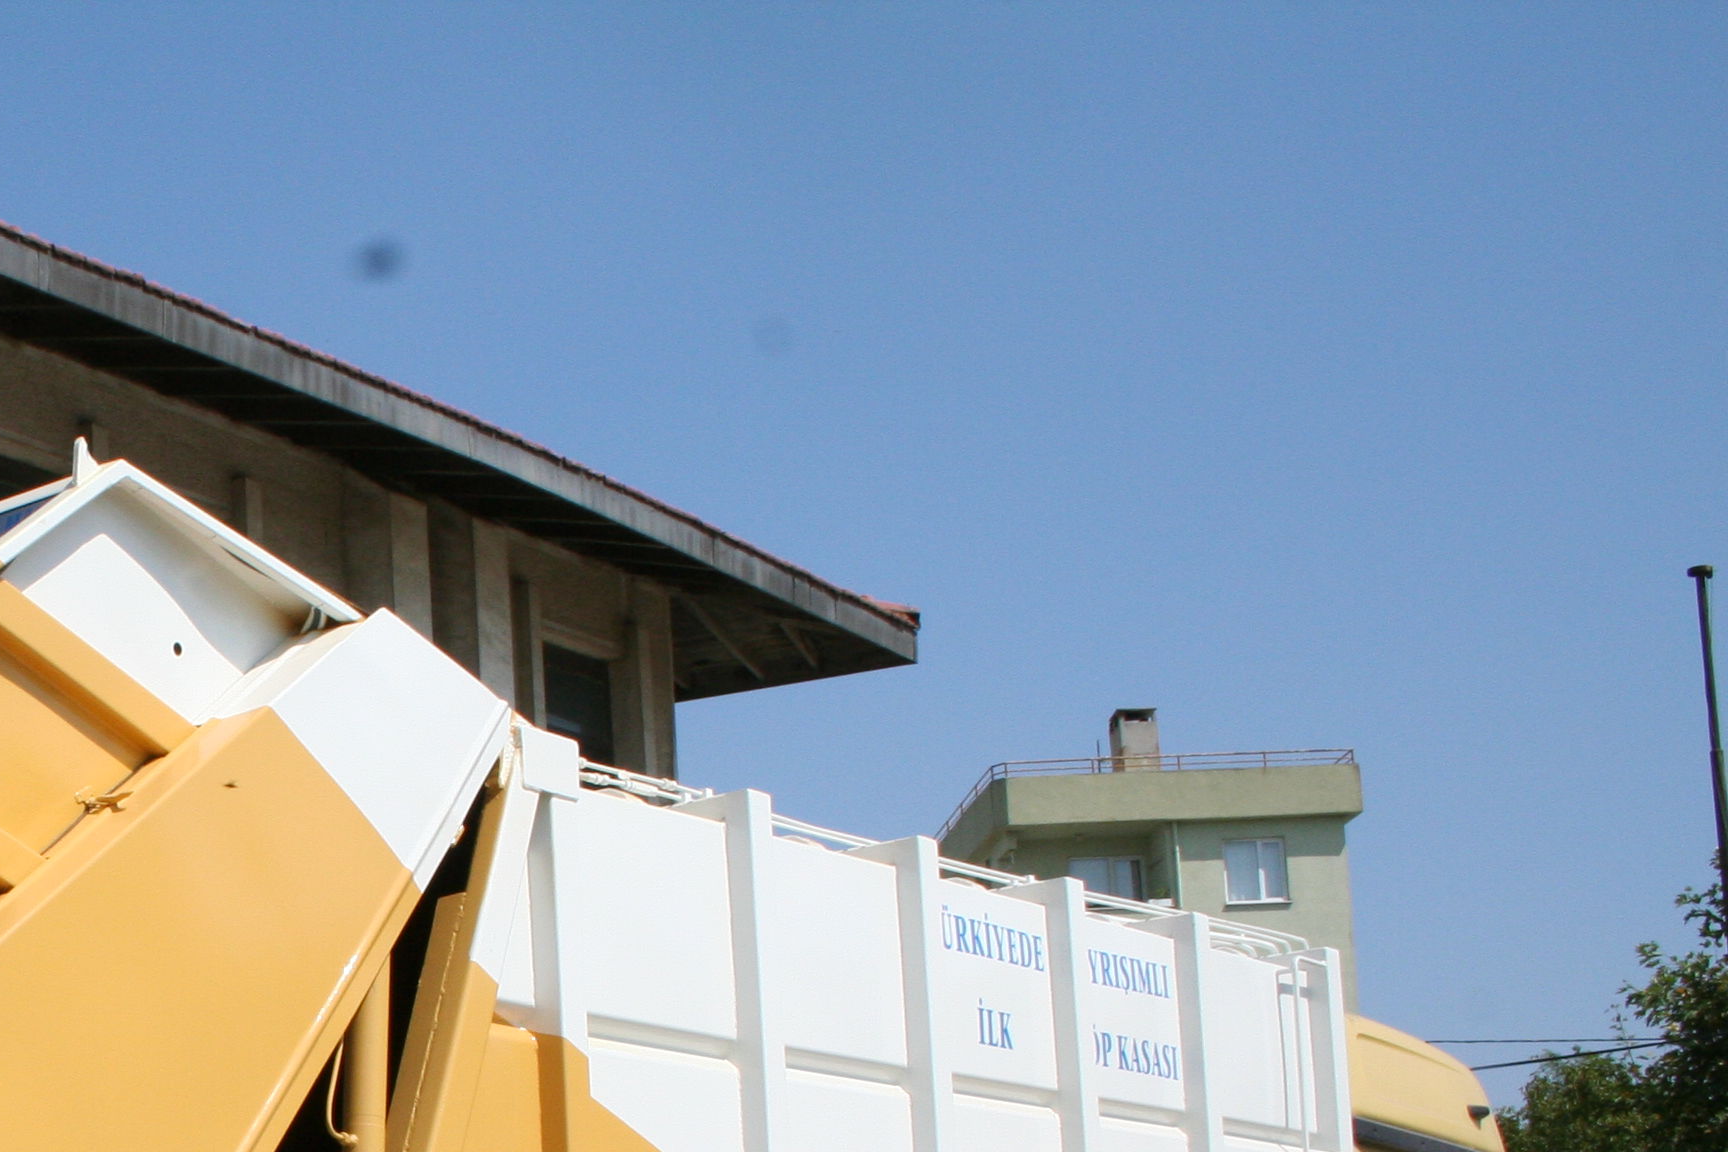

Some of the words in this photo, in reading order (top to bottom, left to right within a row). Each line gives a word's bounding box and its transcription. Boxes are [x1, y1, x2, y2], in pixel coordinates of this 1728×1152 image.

[941, 904, 1045, 972] ÜRKİYEDE
[1088, 948, 1170, 999] YRIŞIMLI
[977, 998, 1014, 1050] İLK
[1116, 1034, 1179, 1081] KASASI
